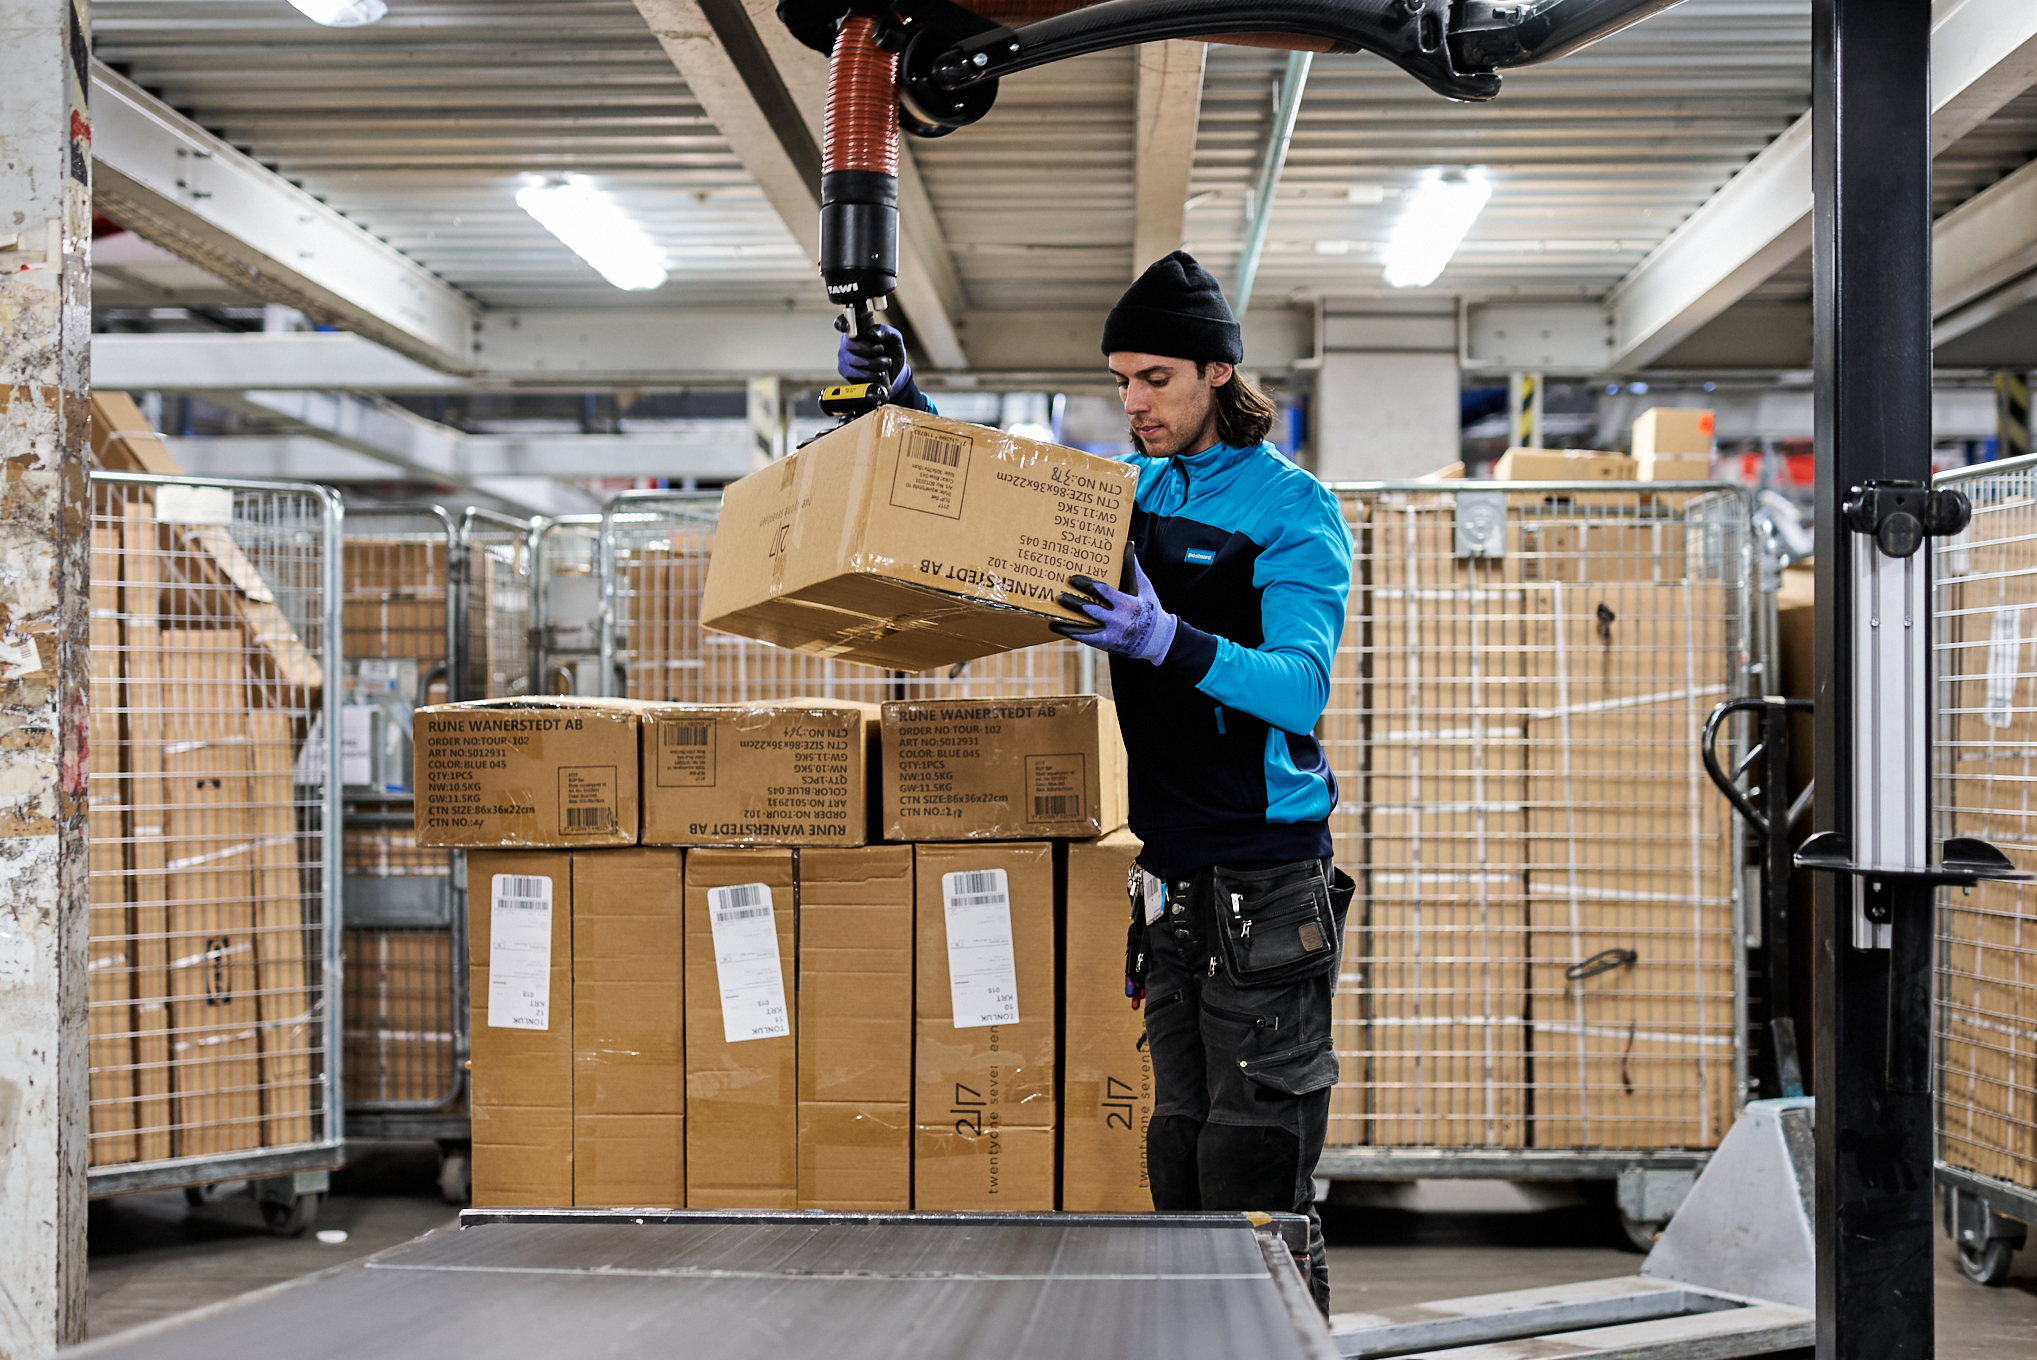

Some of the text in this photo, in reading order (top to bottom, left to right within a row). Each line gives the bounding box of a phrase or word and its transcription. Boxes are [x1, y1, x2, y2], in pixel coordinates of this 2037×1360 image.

[828, 282, 858, 294] TAWI
[1099, 481, 1122, 496] CTN
[1097, 496, 1120, 510] CTN
[1057, 501, 1117, 524] GW:11.5KG
[1054, 515, 1115, 537] NW:10.5KG
[1020, 534, 1039, 547] 045
[1061, 530, 1112, 551] QTY:1PCS
[920, 559, 942, 576] AB
[1086, 566, 1108, 578] ART
[899, 706, 1056, 722] RUNE WANERSTEDT AB
[428, 718, 583, 733] RUNE WANERSTEDT AB
[828, 728, 848, 738] CTN
[899, 726, 932, 736] ORDER
[428, 737, 460, 746] ORDER
[828, 740, 848, 750] CTN
[899, 738, 918, 747] ART
[428, 749, 447, 758] ART
[795, 753, 848, 762] GW:11.5KG
[962, 749, 980, 758] 045
[489, 760, 507, 769] 045
[794, 764, 847, 773] NW:10.5KG
[899, 760, 945, 770] QTY:1PCS
[428, 772, 473, 782] QTY:1PCS
[802, 776, 848, 785] QTY:1PCS
[899, 772, 953, 781] NW:10.5KG
[428, 783, 481, 792] NW:10.5KG
[767, 786, 784, 795] 045
[899, 783, 953, 793] GW:11.5KG
[428, 794, 481, 803] GW:11.5KG
[828, 799, 847, 808] ART
[899, 795, 921, 805] CTN
[428, 806, 448, 816] CTN
[814, 810, 847, 819] ORDER
[900, 807, 921, 817] CTN
[428, 818, 448, 828] CTN
[689, 823, 846, 836] RUNE WANERSTEDT AB
